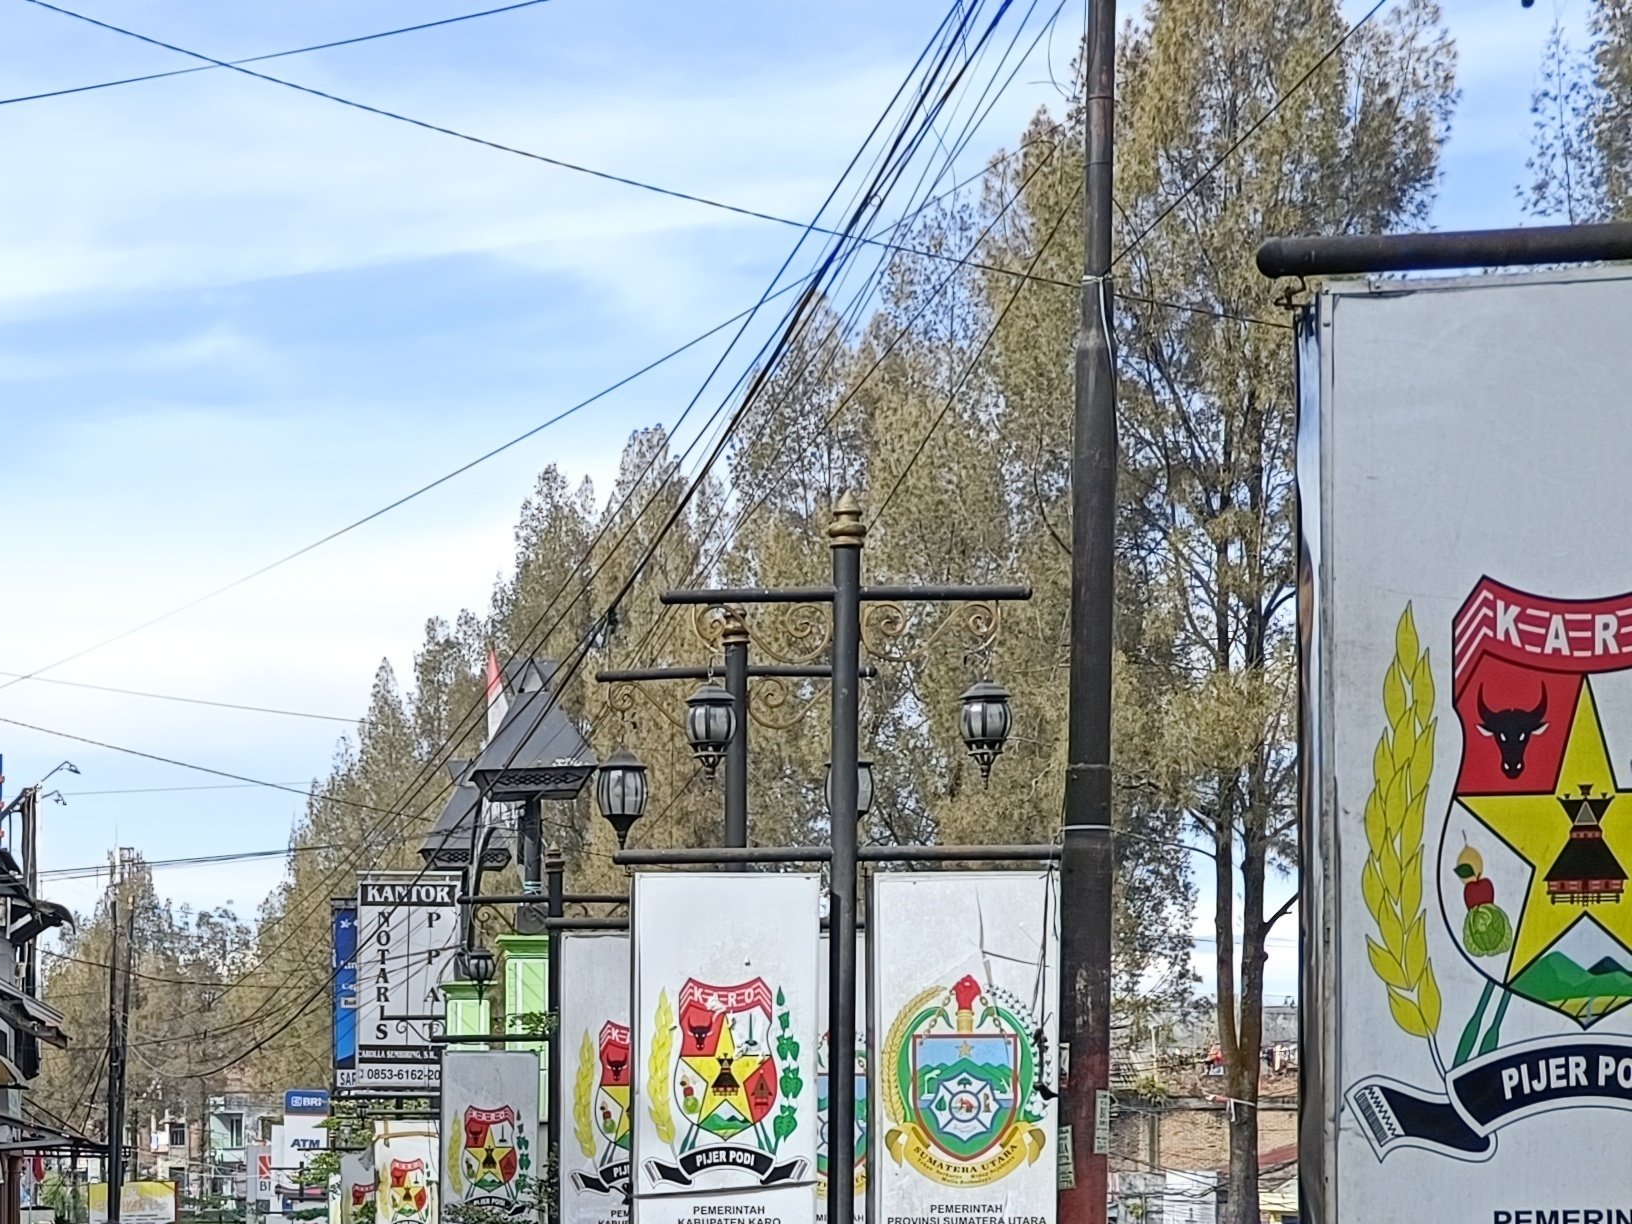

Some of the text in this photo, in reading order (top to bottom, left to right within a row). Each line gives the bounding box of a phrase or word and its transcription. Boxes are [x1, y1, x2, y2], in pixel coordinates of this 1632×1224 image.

[367, 885, 452, 903] KANTOR
[1501, 1056, 1588, 1101] PIJER
[302, 1096, 322, 1107] BRI
[290, 1138, 321, 1148] ATM
[695, 1150, 756, 1166] PIJER PODI
[913, 1143, 1019, 1174] SUMATERA UTARA
[693, 1206, 765, 1216] PEMERINTAH
[930, 1204, 1003, 1214] PEMERINTAH
